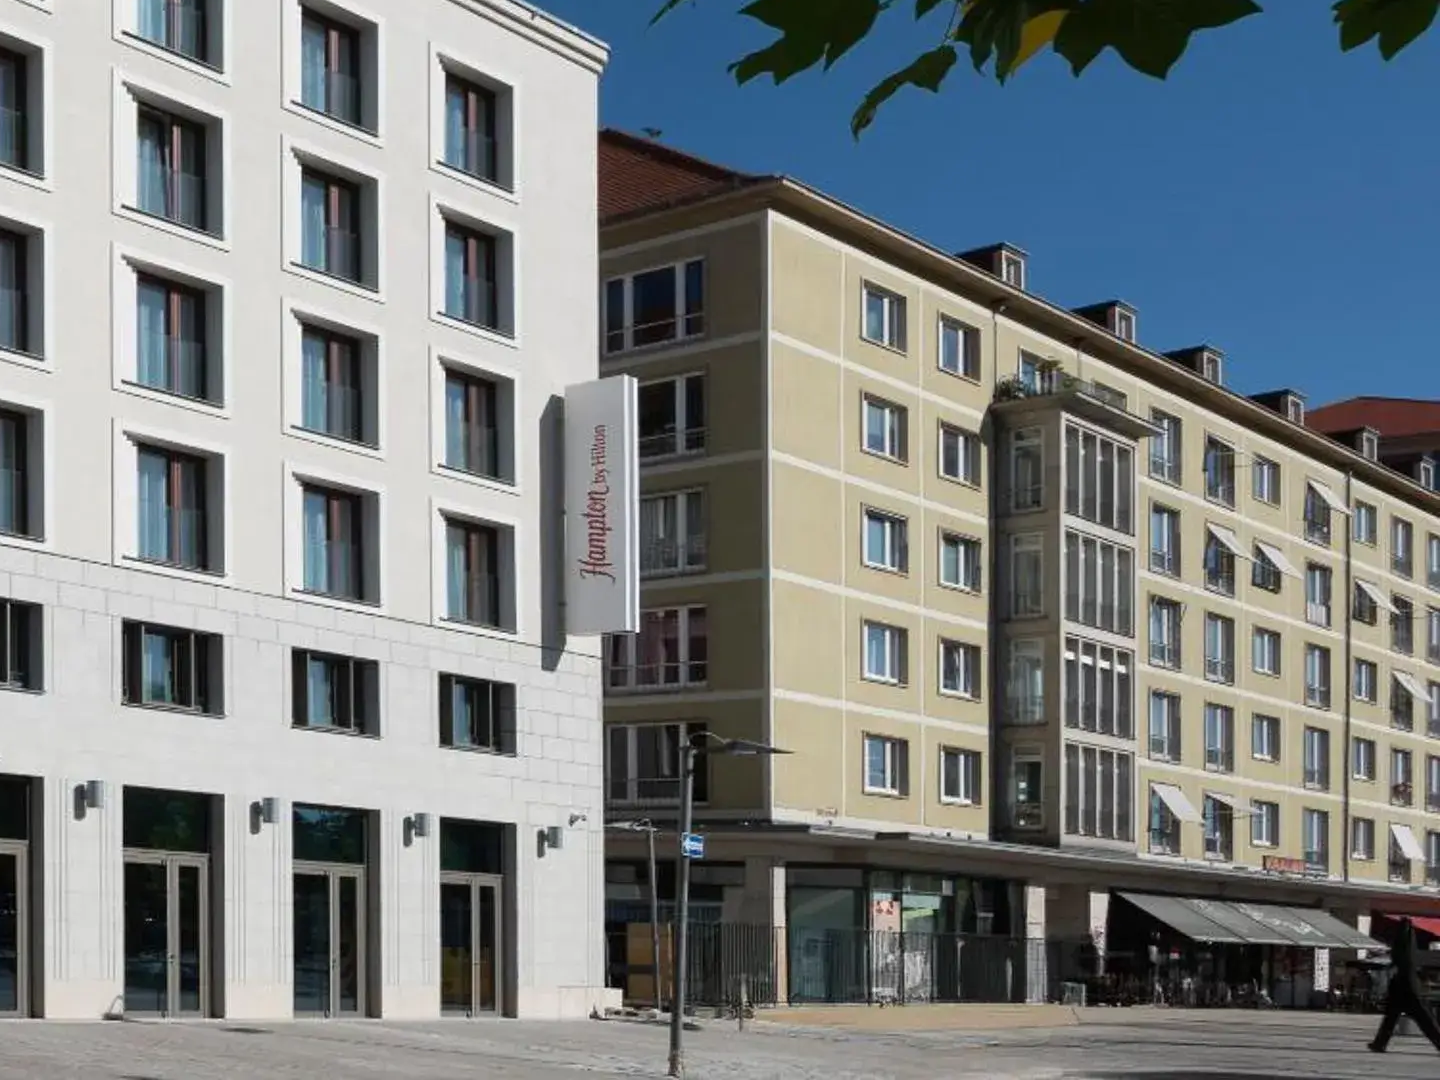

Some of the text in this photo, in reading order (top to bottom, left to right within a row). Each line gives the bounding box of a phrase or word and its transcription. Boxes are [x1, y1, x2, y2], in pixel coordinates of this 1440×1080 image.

[578, 424, 616, 585] Hampton by Hilton
